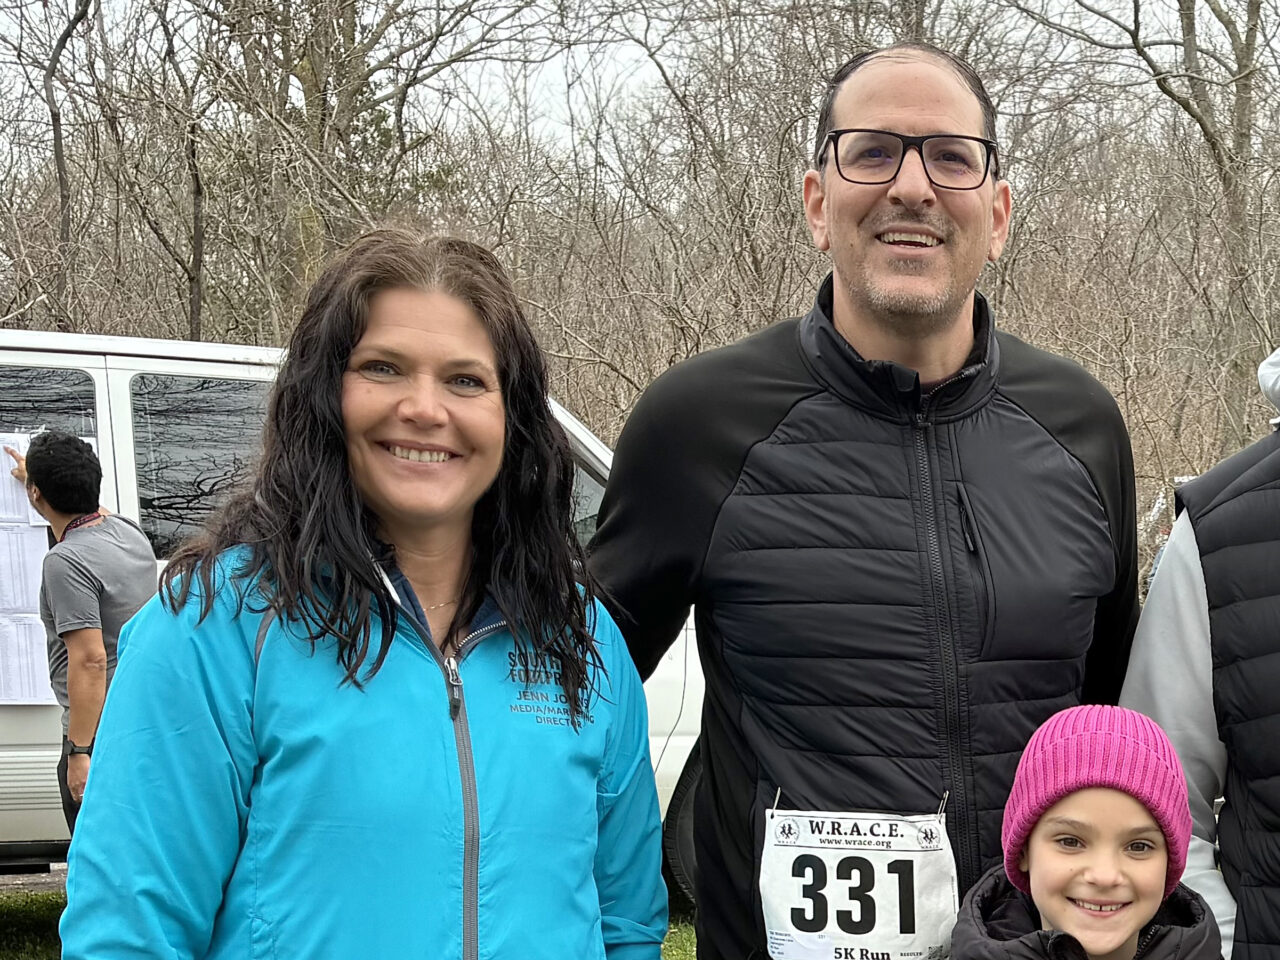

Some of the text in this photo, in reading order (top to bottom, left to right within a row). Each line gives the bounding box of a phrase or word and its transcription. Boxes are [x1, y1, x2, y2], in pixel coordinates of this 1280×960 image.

[516, 690, 588, 708] JENN JONS
[536, 715, 582, 730] DIRECTR
[808, 820, 905, 838] W.R.A.C.E.
[819, 836, 892, 849] www.wrace.org
[790, 853, 916, 936] 331
[834, 947, 892, 960] 5K Run
